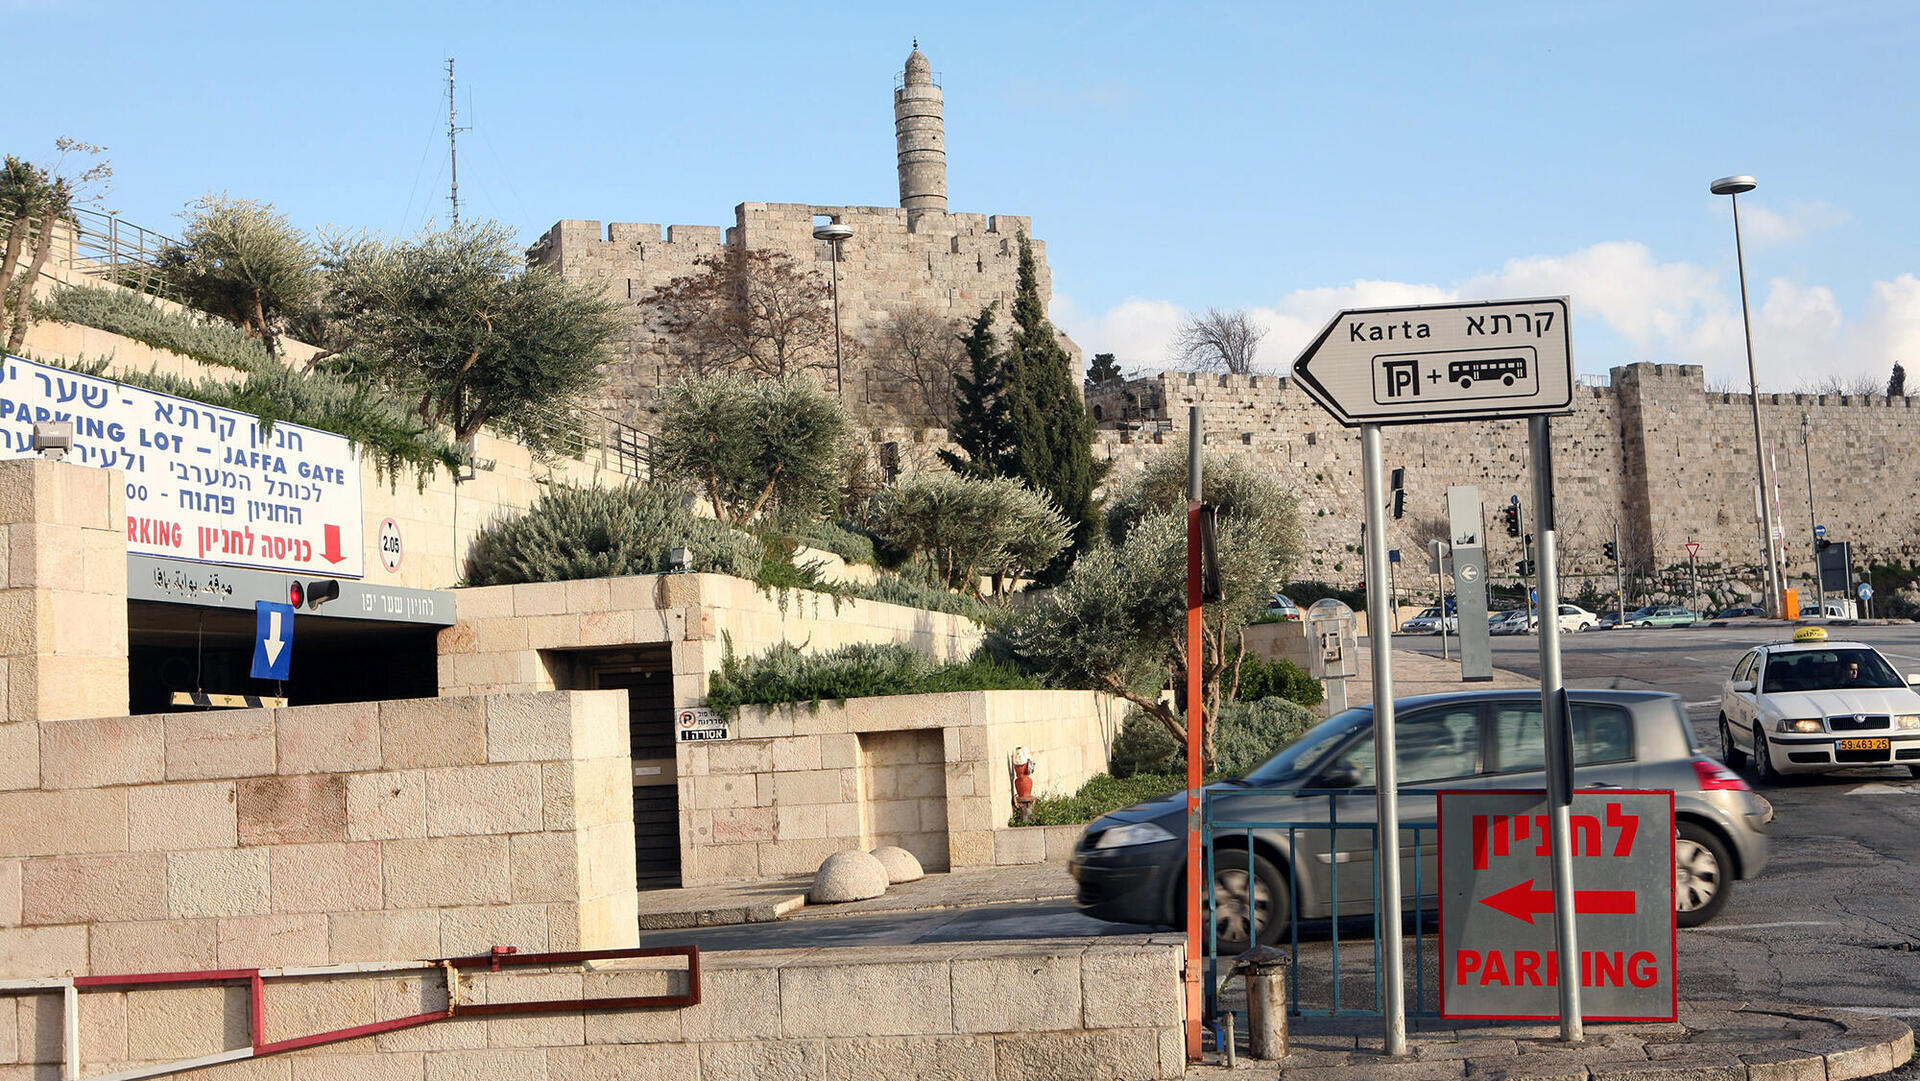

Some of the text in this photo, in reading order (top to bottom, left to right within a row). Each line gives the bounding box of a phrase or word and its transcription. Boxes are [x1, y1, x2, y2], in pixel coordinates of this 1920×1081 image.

[1349, 321, 1431, 342] Karta
[1466, 311, 1555, 338] קרתא
[35, 372, 108, 409] שער
[154, 400, 236, 442] קרתא
[251, 423, 302, 452] חניון
[140, 428, 183, 453] LOT
[224, 446, 287, 474] JAFFA
[298, 461, 344, 485] GATE
[74, 443, 321, 503] לכותל המערבי ולעיר
[126, 483, 147, 501] 00
[179, 489, 234, 515] פתוח
[248, 500, 301, 525] החניון
[127, 515, 182, 548] RKING
[198, 525, 311, 562] כניסה לחניון
[383, 535, 400, 553] 2.05
[361, 593, 434, 619] לחניון שער יפו
[691, 729, 723, 740] אסורה
[1472, 803, 1639, 870] לחניון
